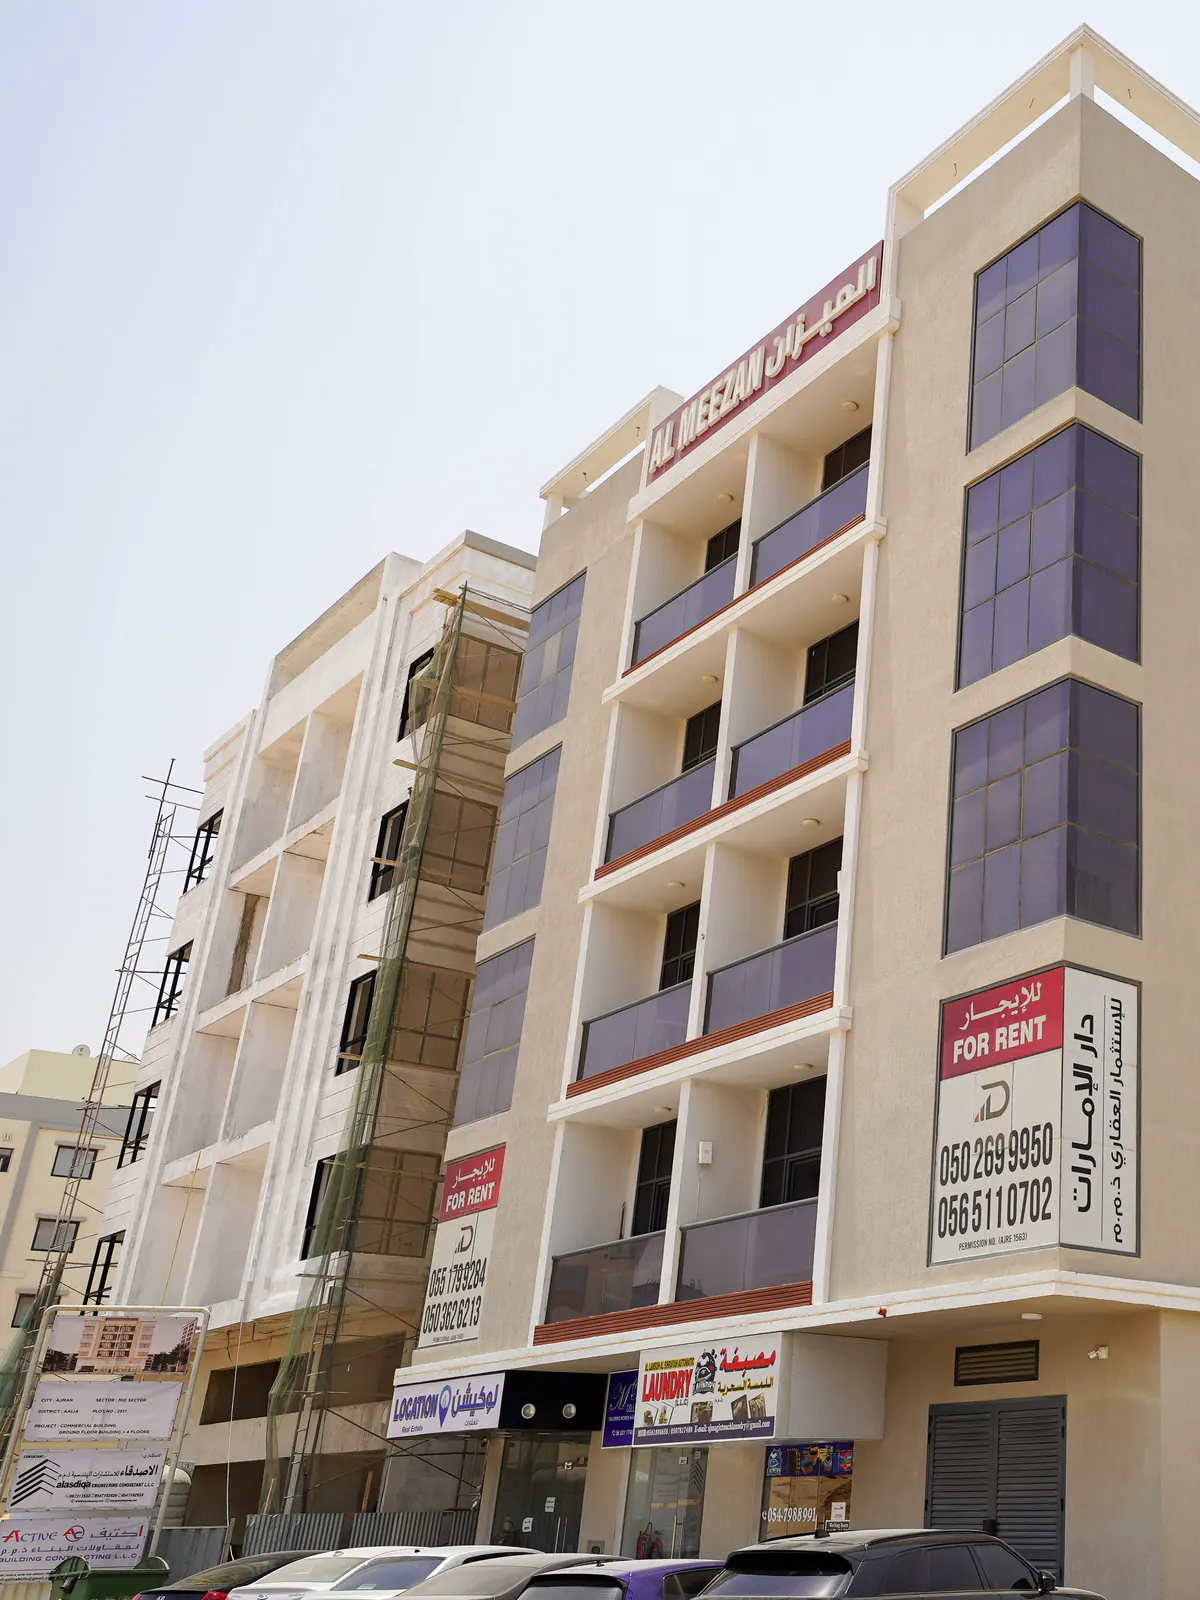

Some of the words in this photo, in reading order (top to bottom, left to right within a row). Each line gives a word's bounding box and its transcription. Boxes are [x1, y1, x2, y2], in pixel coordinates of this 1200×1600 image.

[765, 255, 877, 378] الميزان
[649, 420, 675, 474] AL
[677, 344, 766, 452] MEEZAN
[959, 981, 1043, 1030] للإيجار
[952, 1030, 989, 1064] FOR
[994, 1015, 1047, 1053] RENT
[1073, 1014, 1097, 1058] دار
[1071, 1063, 1099, 1213] الإمارات
[1109, 1090, 1126, 1170] العقاري
[445, 1192, 466, 1213] FOR
[467, 1182, 495, 1206] RENT
[958, 1239, 988, 1251] PERMISSION
[719, 1347, 776, 1377] مصبغة
[451, 1382, 499, 1418] لوكيشن
[642, 1369, 693, 1402] LAUNDRY
[393, 1394, 439, 1422] LOCATION
[411, 1424, 423, 1433] Estate
[56, 1480, 91, 1489] alasdiqa
[120, 1465, 159, 1476] الاصدقاء
[2, 1530, 58, 1543] ACTIVE
[90, 1525, 144, 1540] اكتيف
